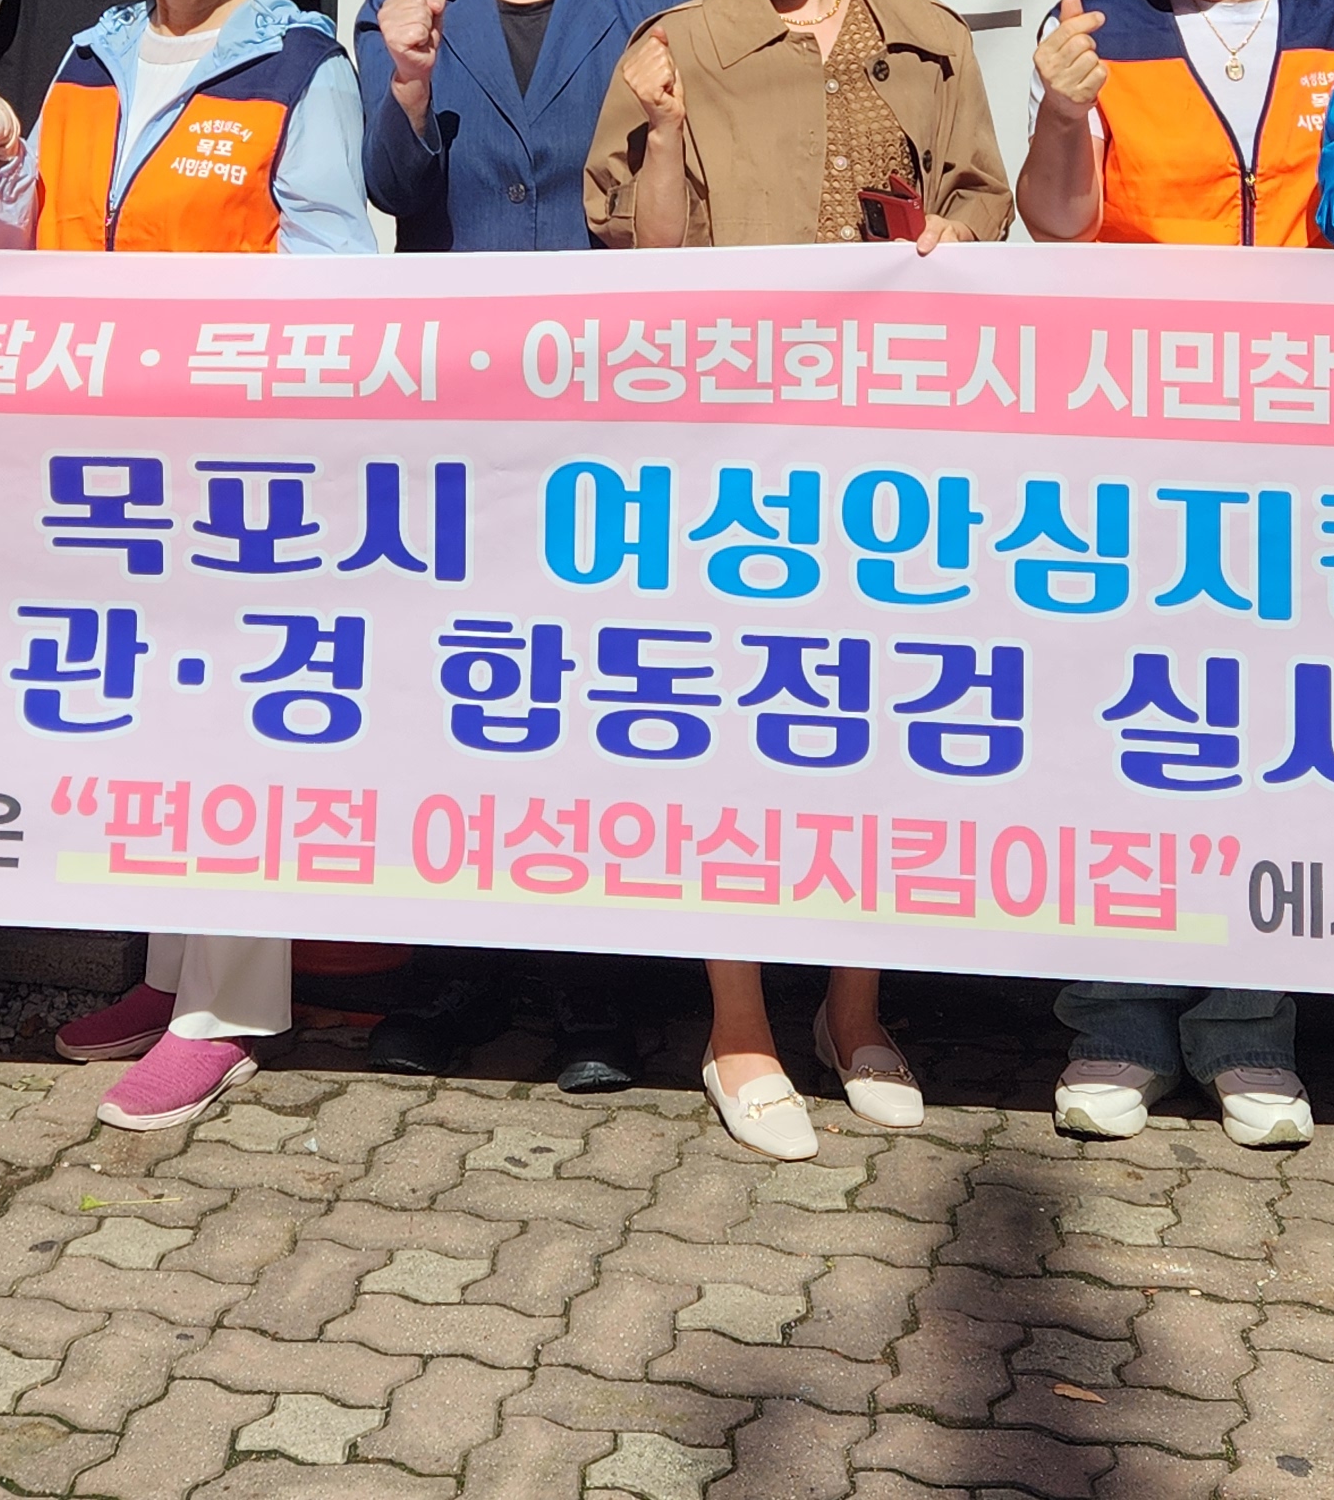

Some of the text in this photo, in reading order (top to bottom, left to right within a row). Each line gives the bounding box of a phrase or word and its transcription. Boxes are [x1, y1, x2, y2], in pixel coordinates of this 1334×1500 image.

[170, 157, 248, 186] 시민참여단
[187, 320, 439, 403] 목포시
[520, 318, 1038, 415] 여성친화도시
[41, 455, 469, 584] 목포시
[437, 614, 1027, 777] 합동점검
